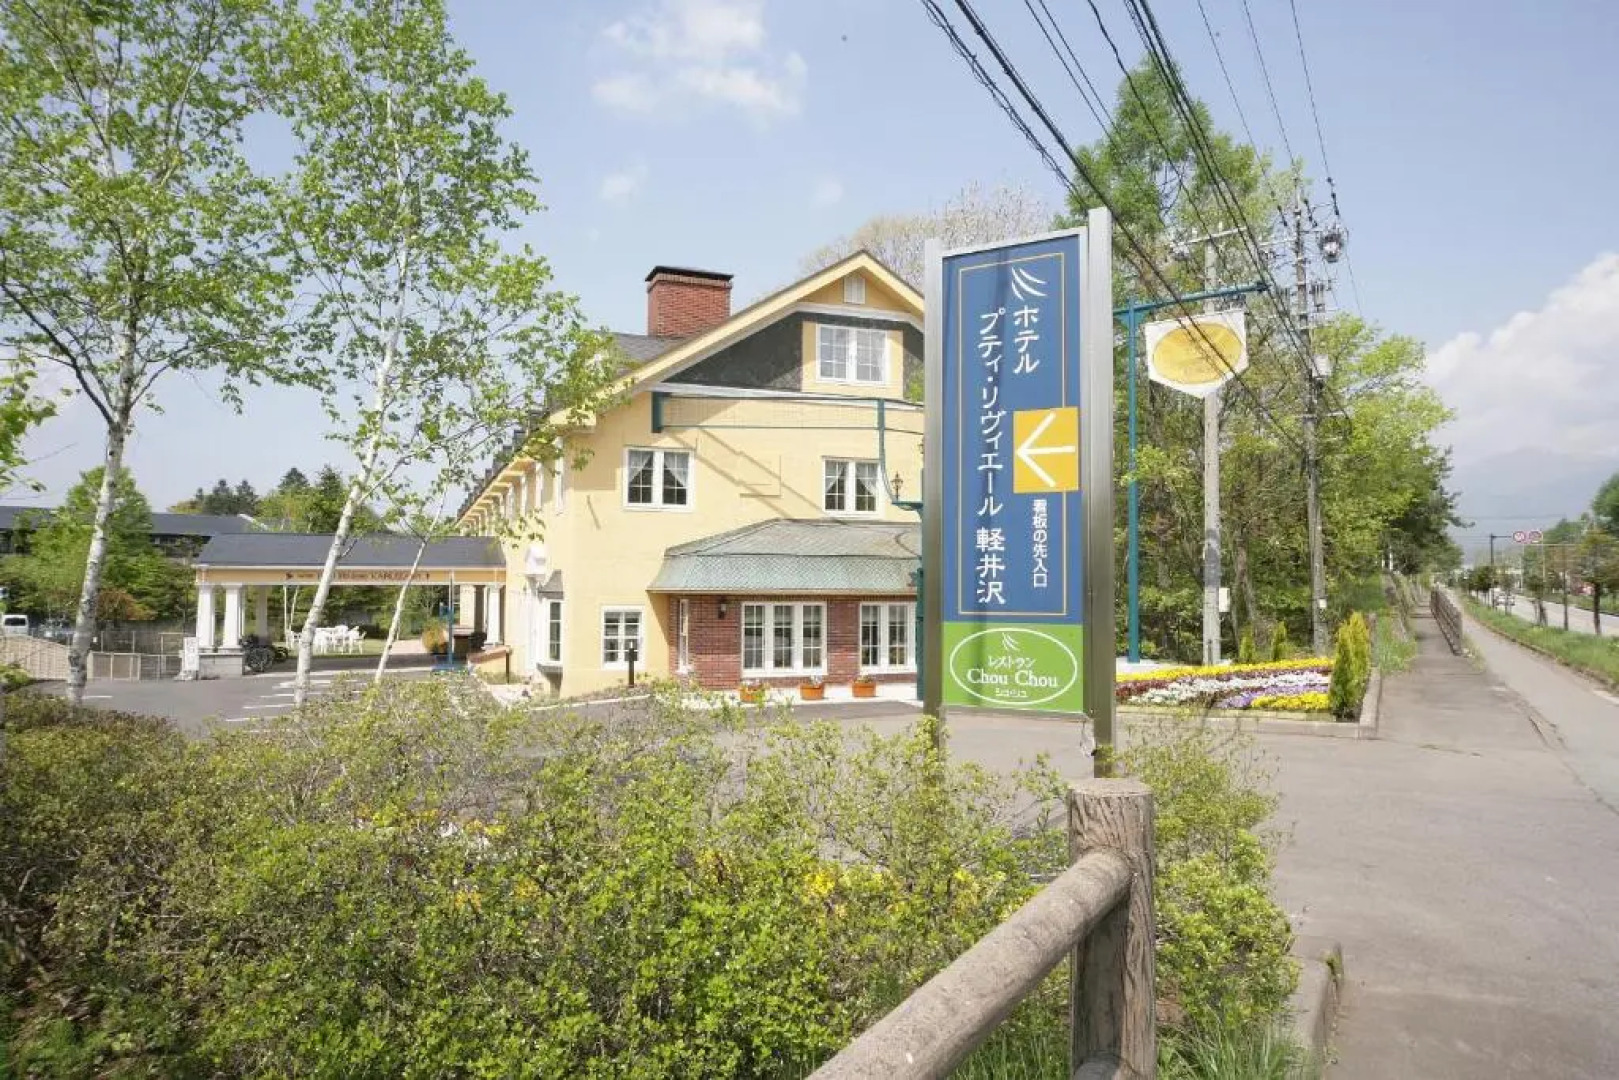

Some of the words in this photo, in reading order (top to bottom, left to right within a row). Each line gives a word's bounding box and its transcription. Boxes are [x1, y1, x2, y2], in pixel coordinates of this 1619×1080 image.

[1013, 306, 1040, 374] ホテル
[977, 308, 1007, 517] プティ・リヴィエール
[976, 526, 1007, 604] 軽井沢
[1033, 499, 1048, 588] 看板の先入口
[967, 668, 1008, 685] Chou
[1014, 669, 1058, 687] Chou
[987, 655, 1036, 669] レストラン
